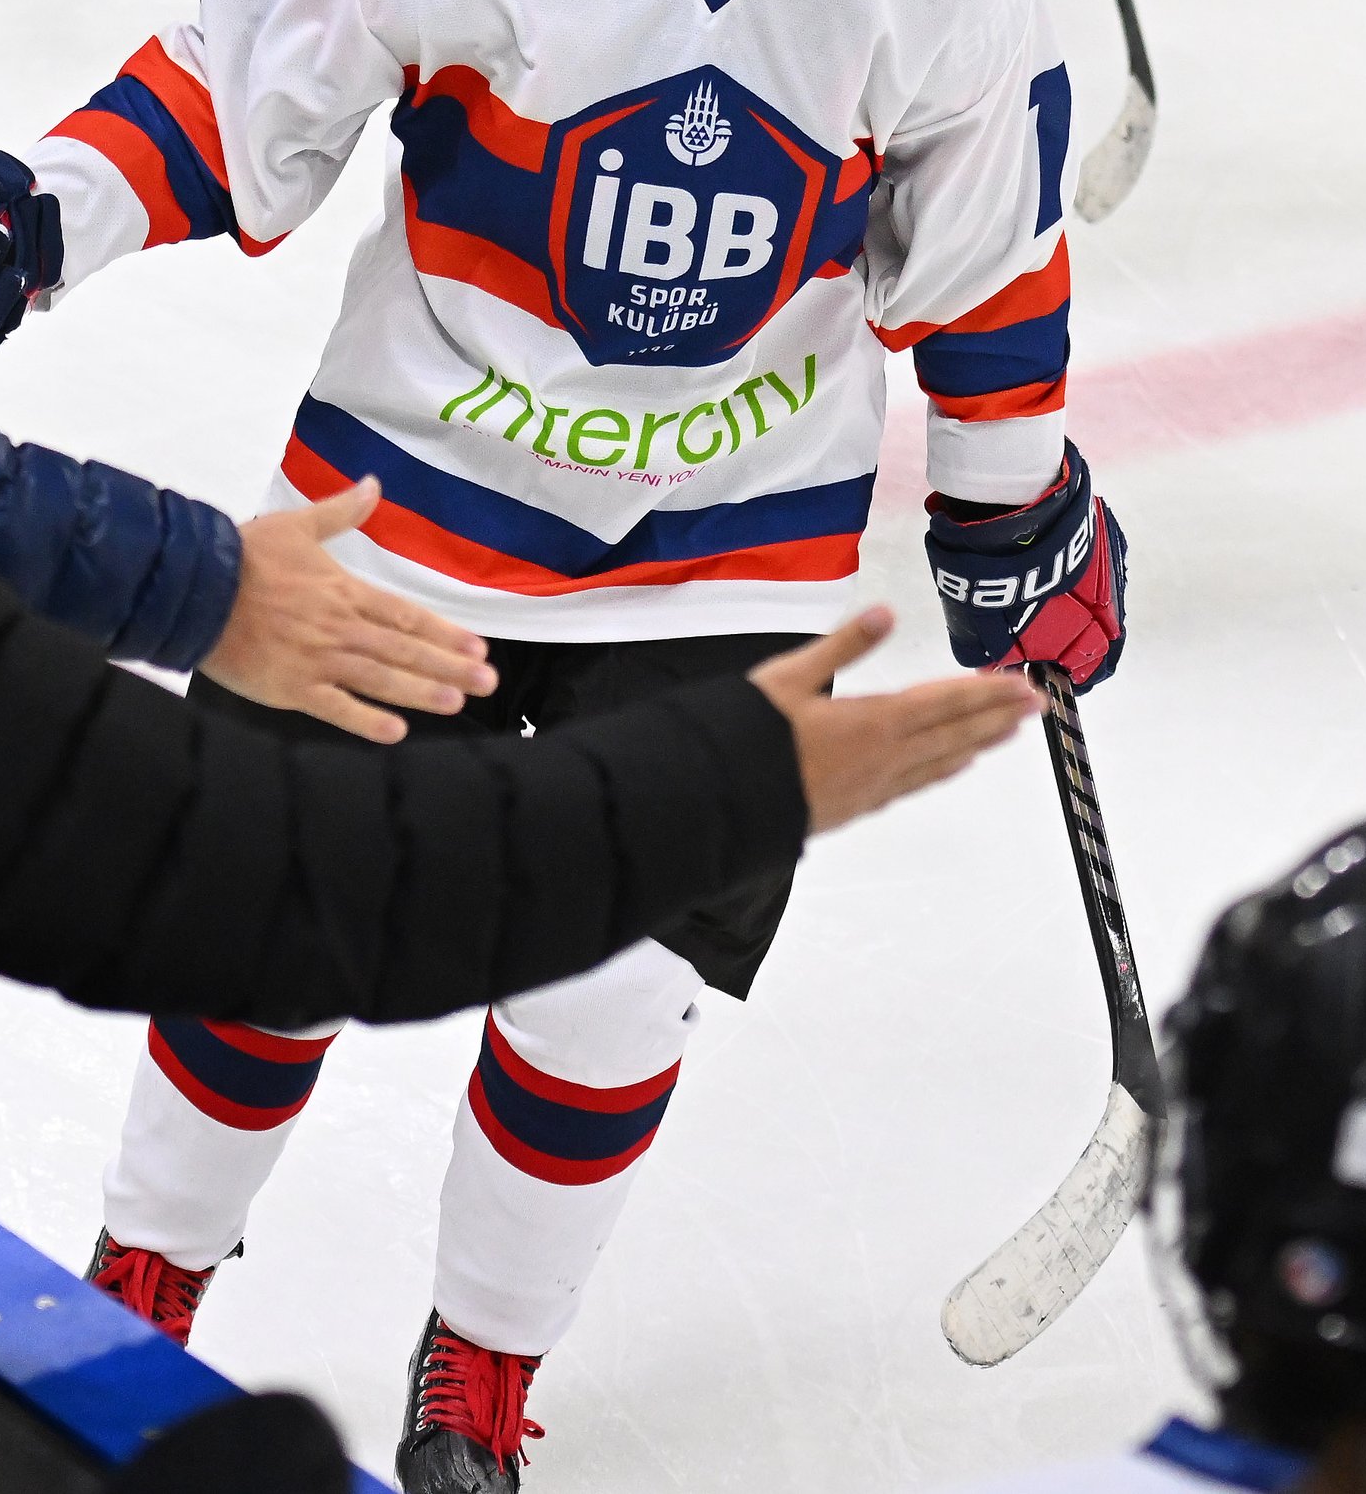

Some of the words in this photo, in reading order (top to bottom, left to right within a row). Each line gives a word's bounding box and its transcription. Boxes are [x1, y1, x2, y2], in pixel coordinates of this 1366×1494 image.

[1027, 59, 1072, 240] 1
[630, 284, 708, 308] SPOR
[607, 302, 719, 337] KULÜBÜ
